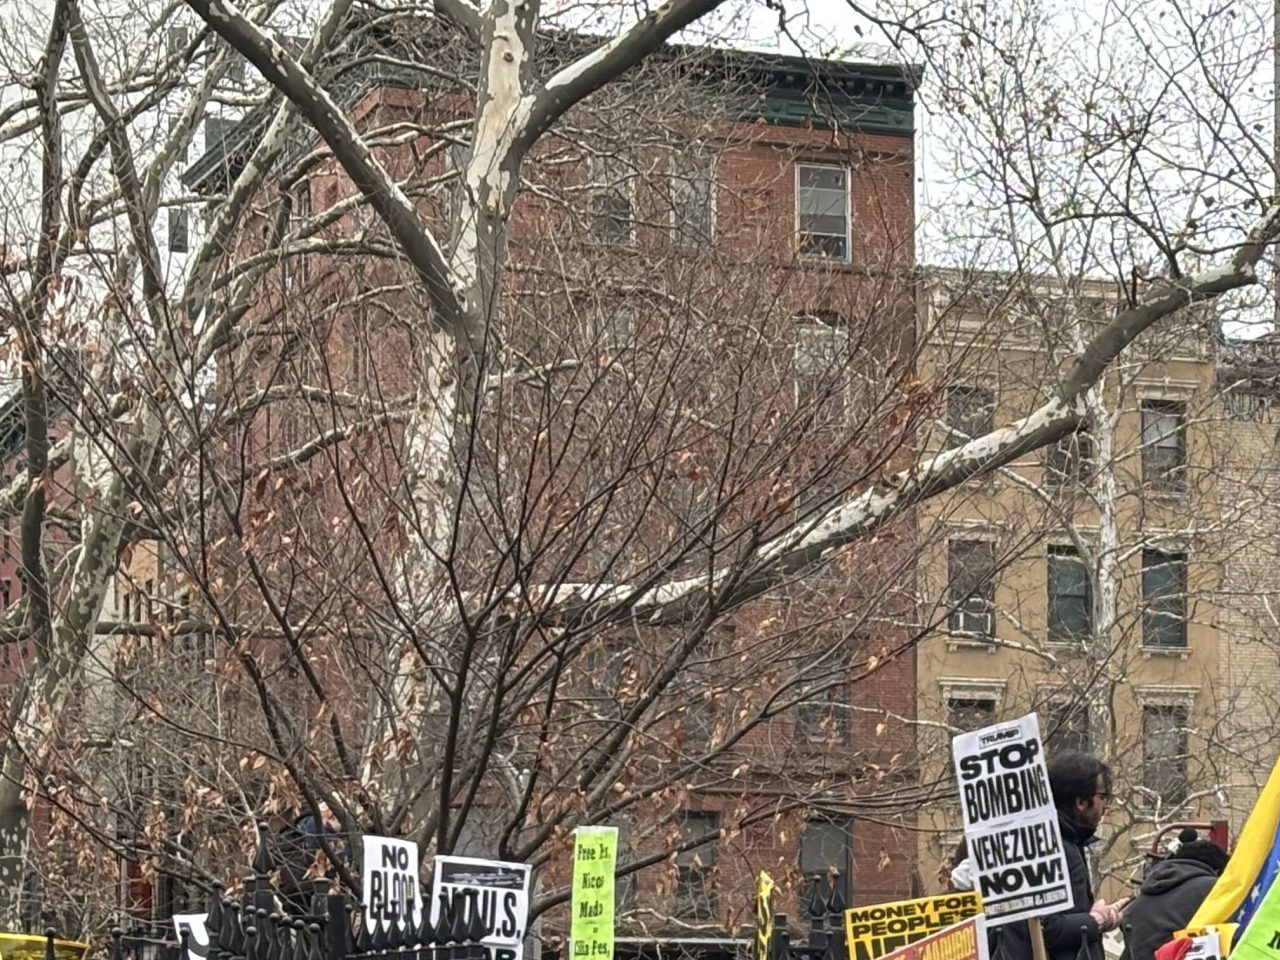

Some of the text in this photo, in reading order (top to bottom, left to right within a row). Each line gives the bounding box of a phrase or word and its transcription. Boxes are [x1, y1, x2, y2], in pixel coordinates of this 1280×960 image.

[981, 729, 1020, 745] TRUMP
[959, 737, 1040, 781] STOP
[964, 763, 1050, 825] BOMBING
[381, 844, 409, 871] NO
[971, 819, 1061, 872] VENEZUELA
[979, 857, 1064, 898] NOW!
[851, 900, 929, 924] MONEY
[933, 894, 977, 911] FOR
[852, 907, 977, 939] PEOPLE'S
